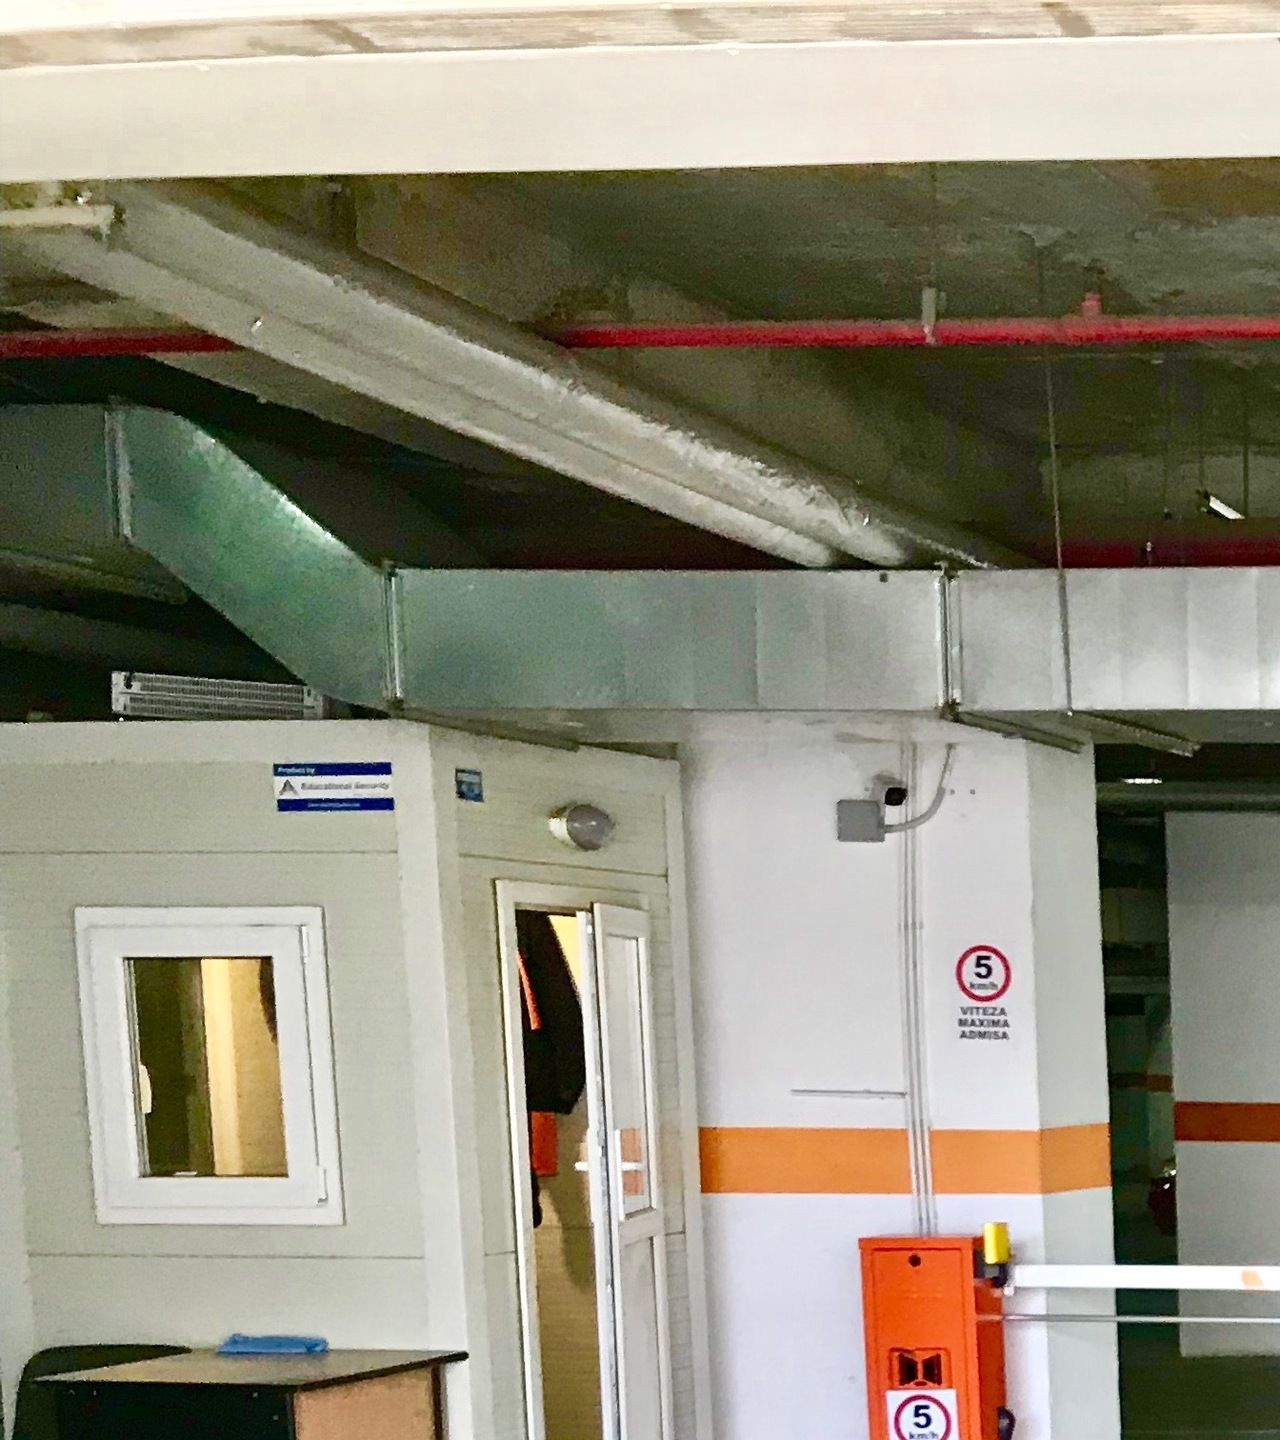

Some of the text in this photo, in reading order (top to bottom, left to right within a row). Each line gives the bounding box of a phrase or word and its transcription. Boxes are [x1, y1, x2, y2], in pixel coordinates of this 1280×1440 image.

[301, 782, 390, 791] Educational Security
[973, 955, 993, 979] 5
[960, 1006, 1007, 1017] VITEZA
[958, 1018, 1010, 1028] MAXIMA
[959, 1029, 1010, 1040] ADMISA
[913, 1404, 932, 1429] 5
[908, 1431, 939, 1440] km/h
